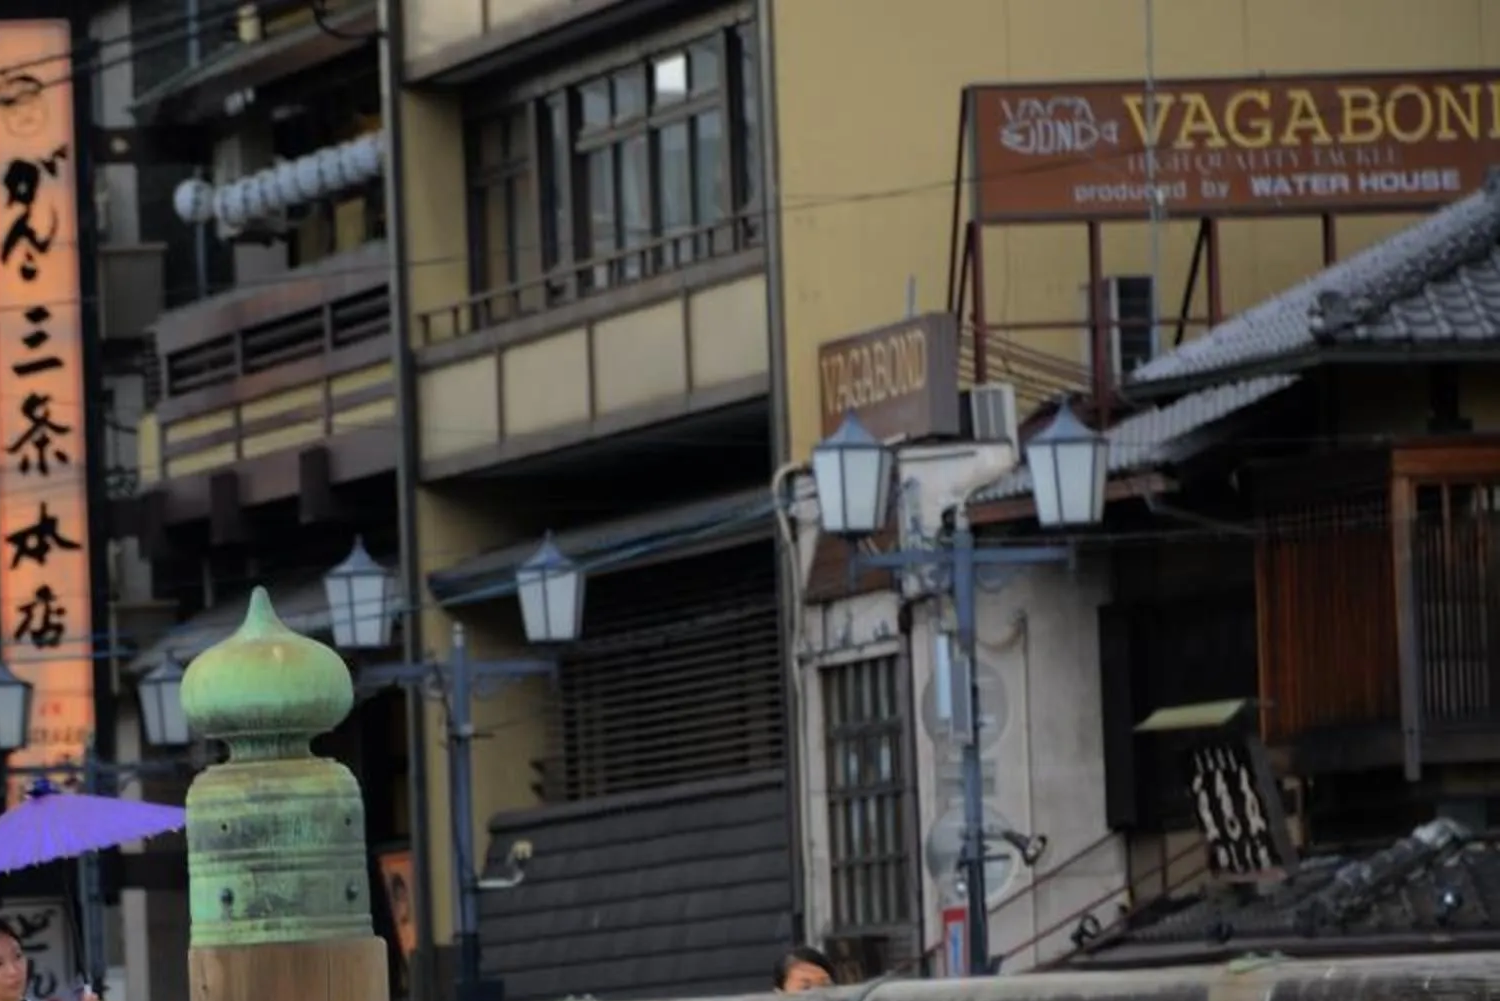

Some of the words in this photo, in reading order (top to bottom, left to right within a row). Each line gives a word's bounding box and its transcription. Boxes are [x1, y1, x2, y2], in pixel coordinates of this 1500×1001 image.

[1122, 83, 1500, 149] VAGABON
[1075, 180, 1187, 203] produced
[1202, 180, 1231, 199] by
[1252, 171, 1350, 198] WATER
[1359, 169, 1461, 192] HOUSE
[821, 329, 926, 415] VAGABOND
